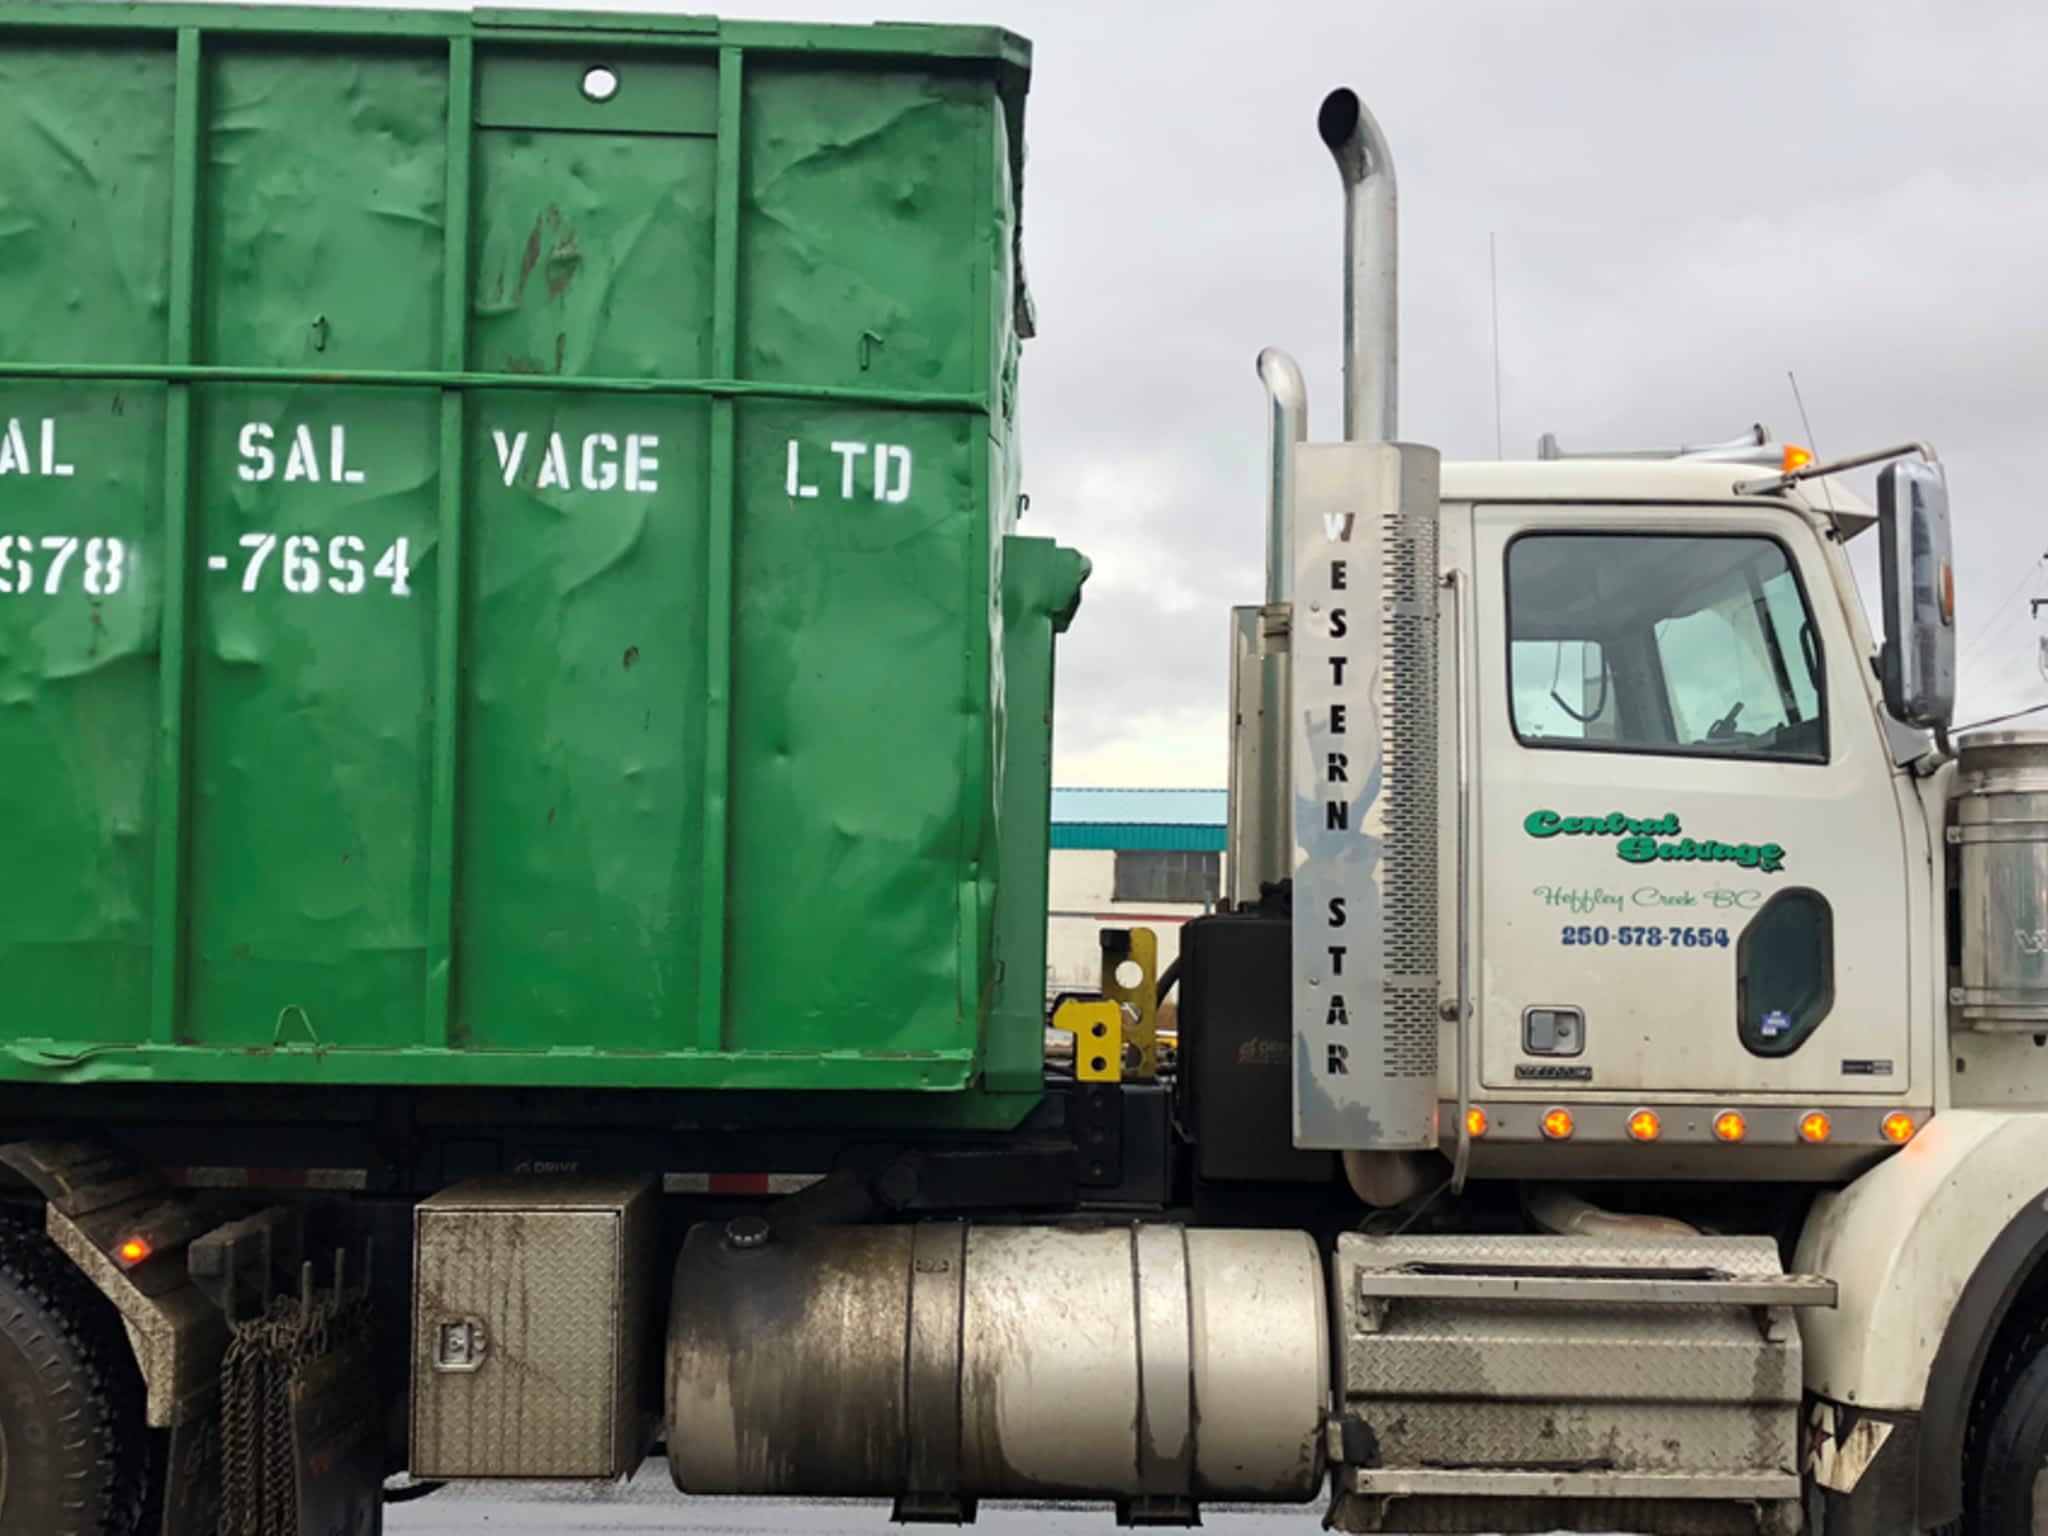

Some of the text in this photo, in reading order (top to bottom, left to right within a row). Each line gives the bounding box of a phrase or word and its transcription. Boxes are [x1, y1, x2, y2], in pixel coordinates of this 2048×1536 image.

[0, 417, 913, 504] AL SAL VAGE LTD
[1322, 511, 1355, 1075] WESTERN STAR
[1523, 808, 1683, 838] Central
[1616, 835, 1787, 874] Salvage
[1703, 888, 1763, 910] BC
[1561, 925, 1731, 948] 250-578-7654
